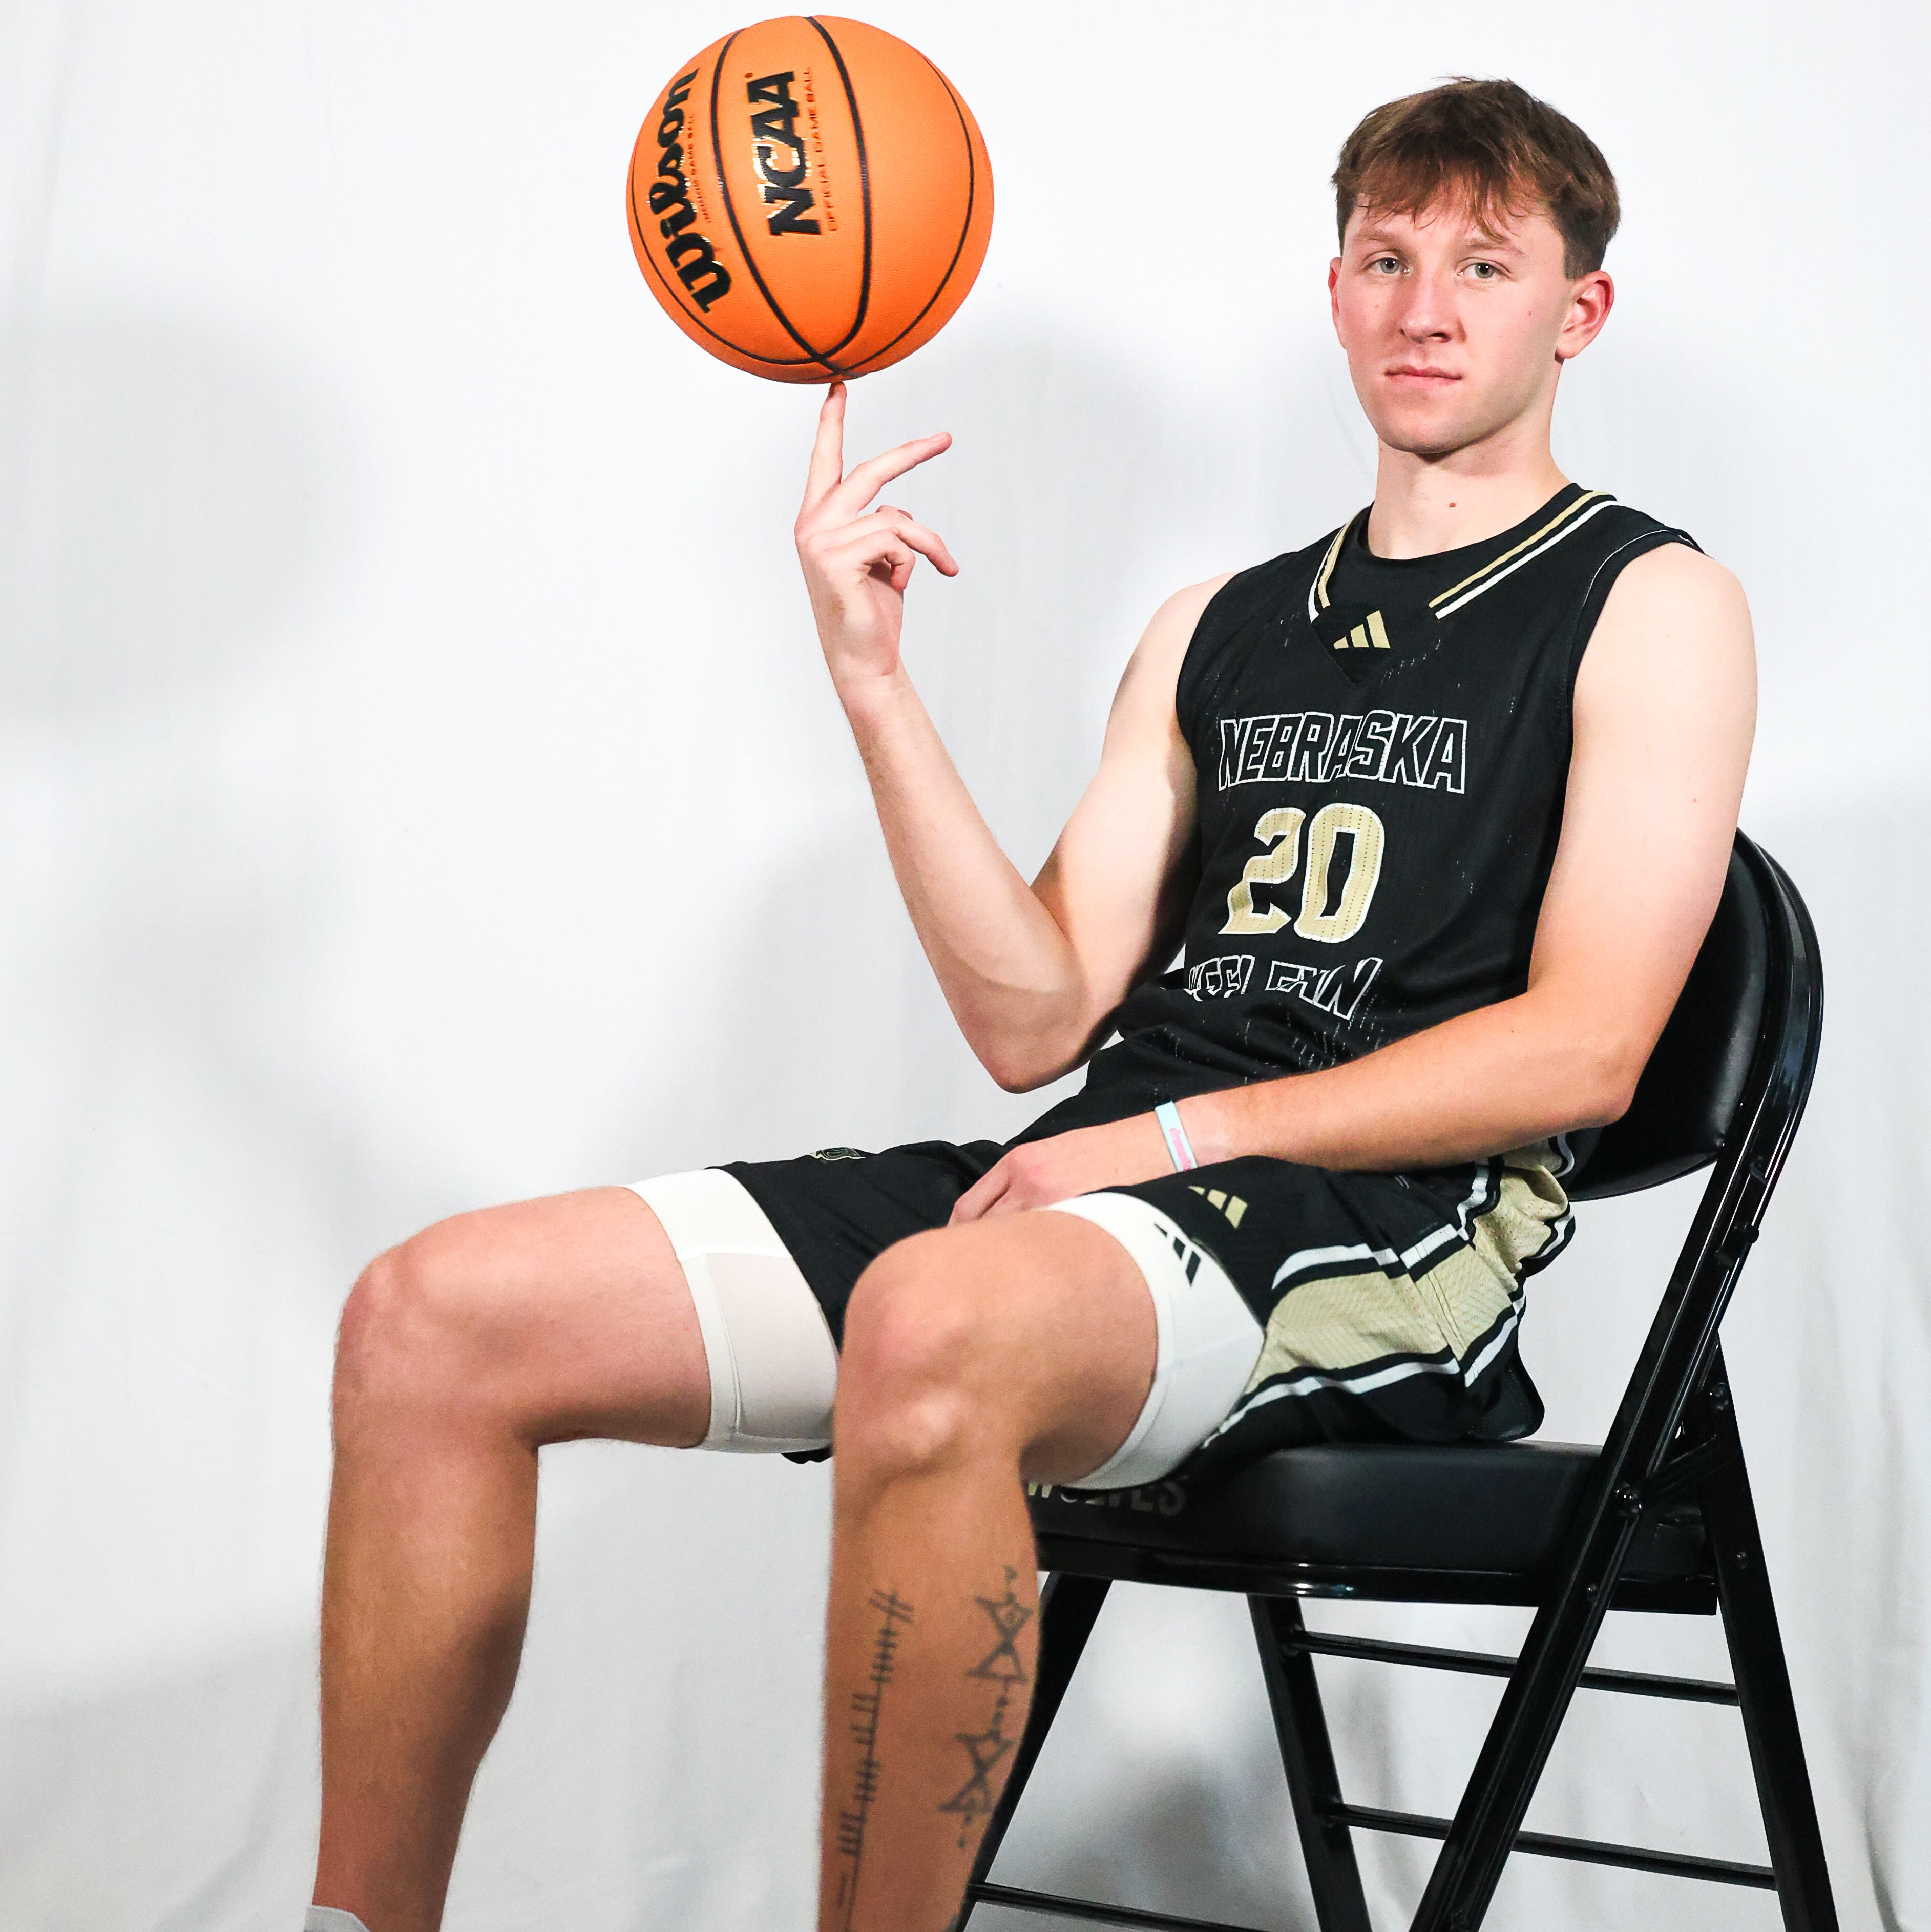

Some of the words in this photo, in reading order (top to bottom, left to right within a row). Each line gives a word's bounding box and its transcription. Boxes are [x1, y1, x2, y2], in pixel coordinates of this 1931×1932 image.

[803, 67, 814, 102] BALL
[747, 71, 821, 236] NCAA
[808, 106, 823, 152] GAME
[648, 68, 732, 314] Wilson
[818, 156, 838, 232] OFFICIAL
[1219, 710, 1468, 794] NEBRASKA
[1218, 802, 1386, 944] 20
